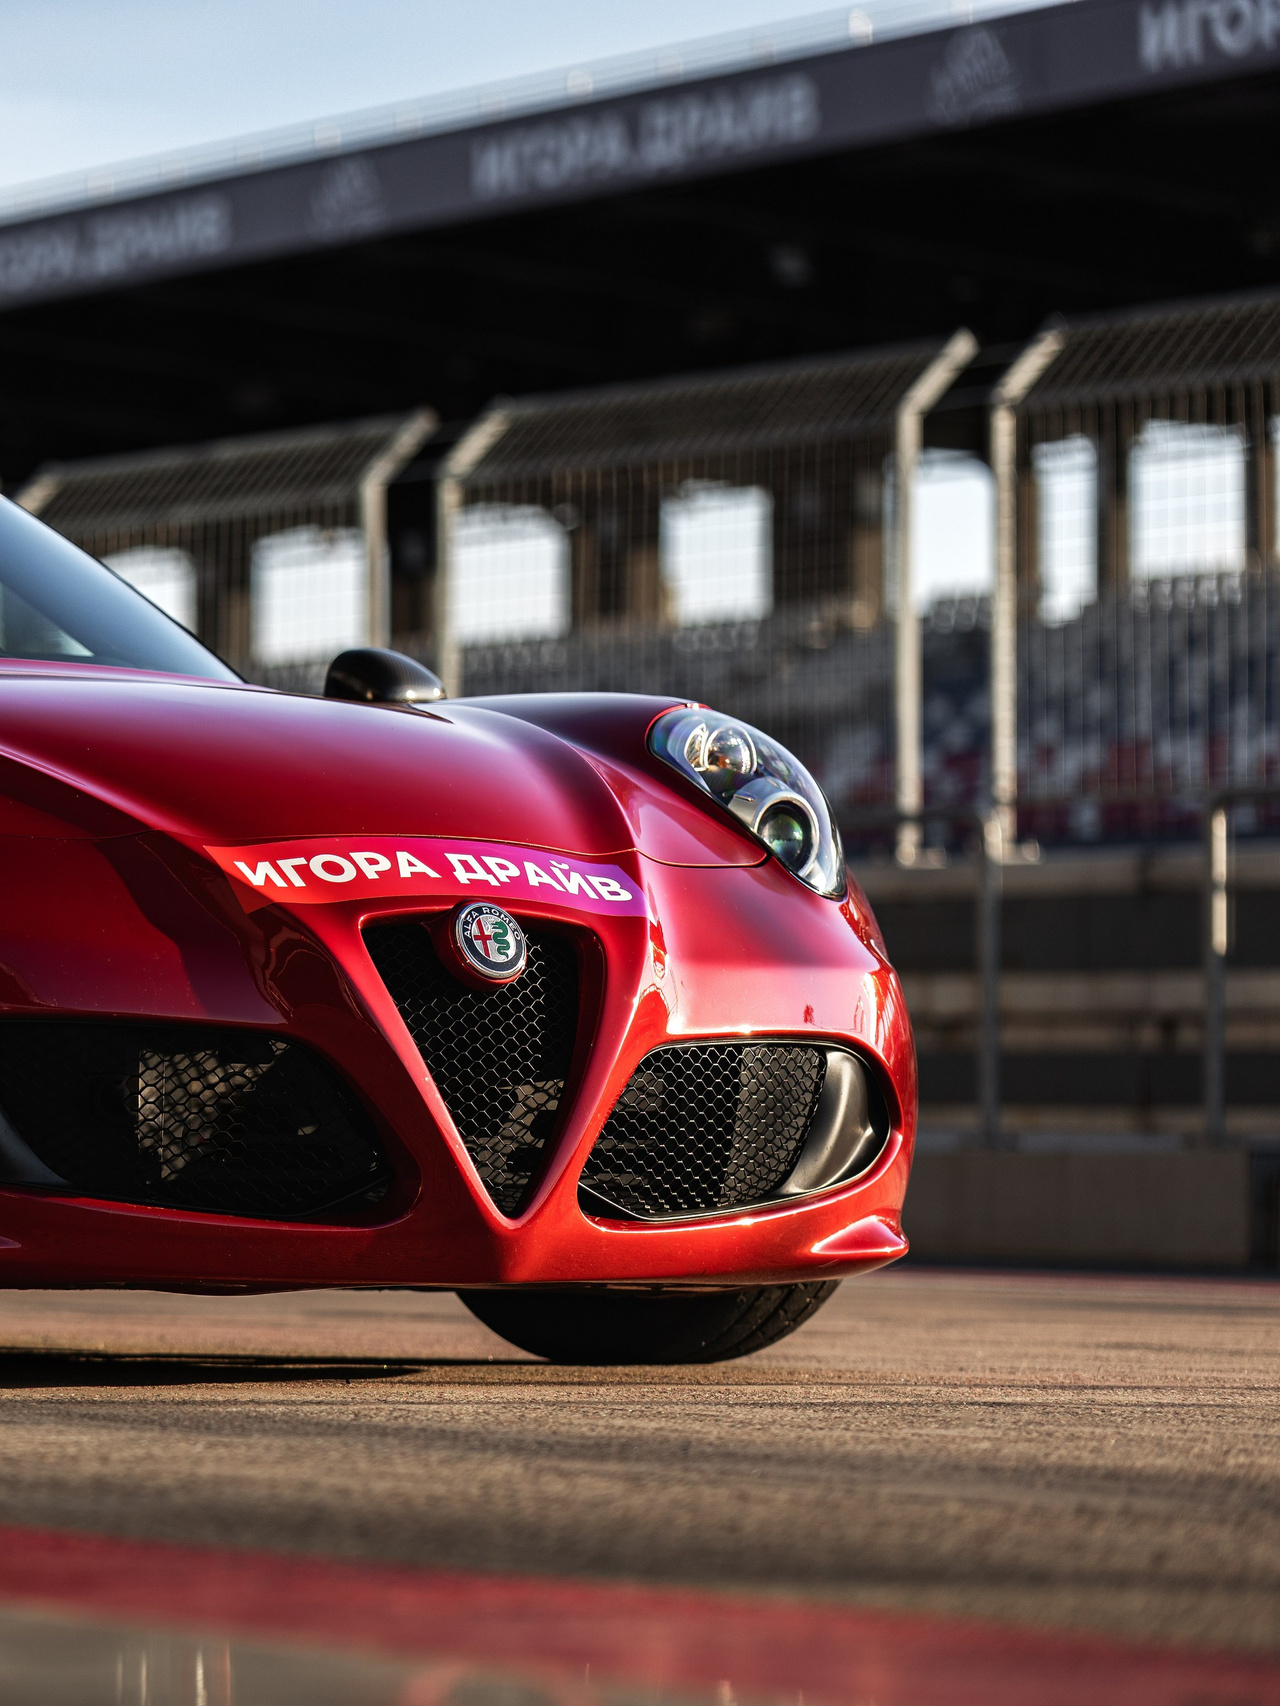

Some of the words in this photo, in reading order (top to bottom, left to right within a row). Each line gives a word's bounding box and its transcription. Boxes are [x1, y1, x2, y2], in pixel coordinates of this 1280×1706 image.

[233, 850, 441, 889] ИГОРА
[444, 852, 633, 903] ДРАЙВ
[463, 910, 480, 939] ALFA
[481, 906, 521, 941] ROMEO
